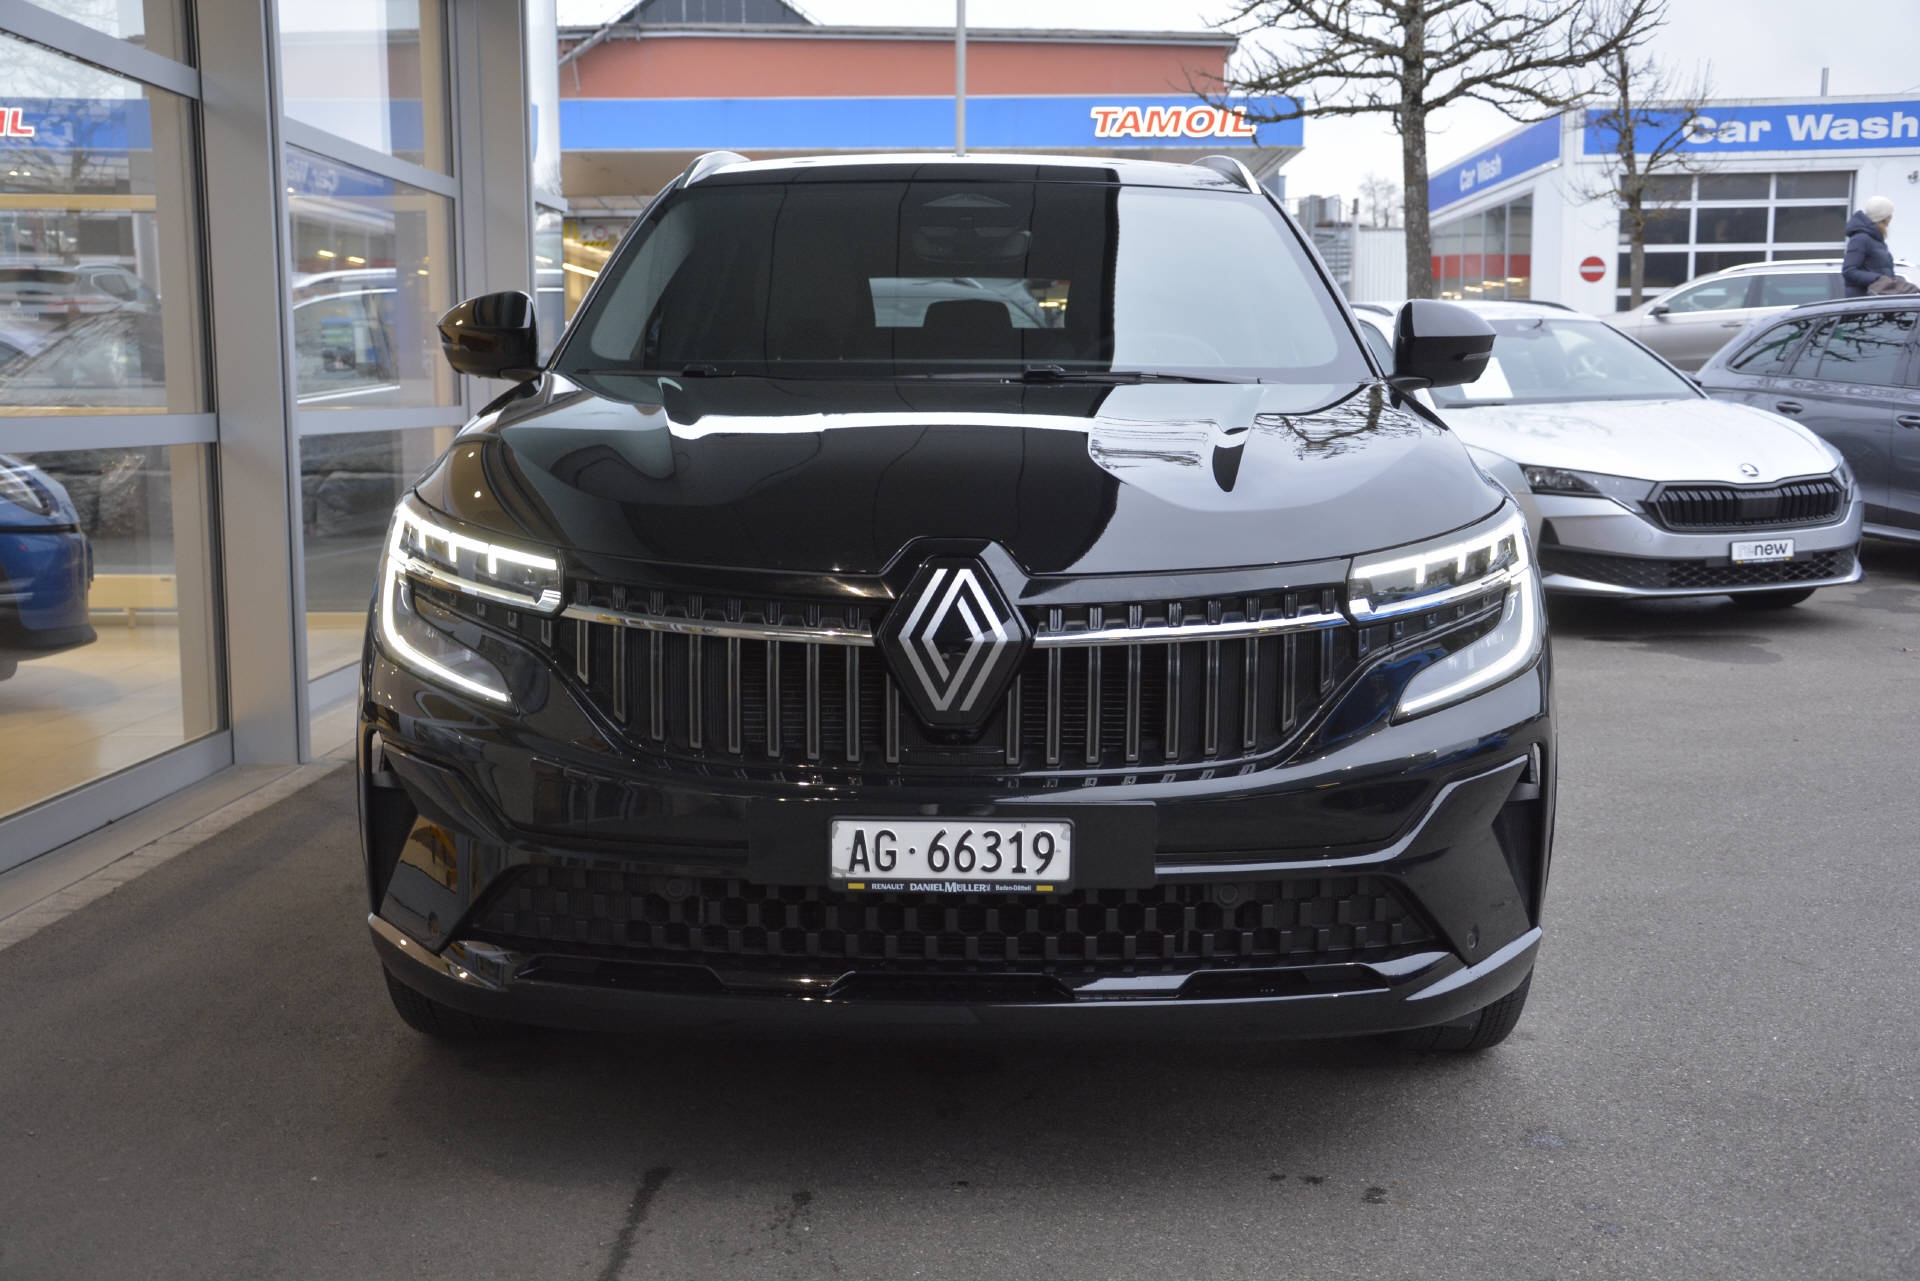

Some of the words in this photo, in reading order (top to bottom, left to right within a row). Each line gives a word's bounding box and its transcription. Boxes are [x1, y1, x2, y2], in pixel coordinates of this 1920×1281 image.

[1090, 105, 1258, 138] TAMOIL
[1682, 116, 1772, 145] Car
[1786, 111, 1919, 142] Wash
[1460, 168, 1476, 192] Car
[1476, 153, 1502, 184] Wash
[849, 829, 897, 873] AG
[927, 827, 1056, 875] 66319
